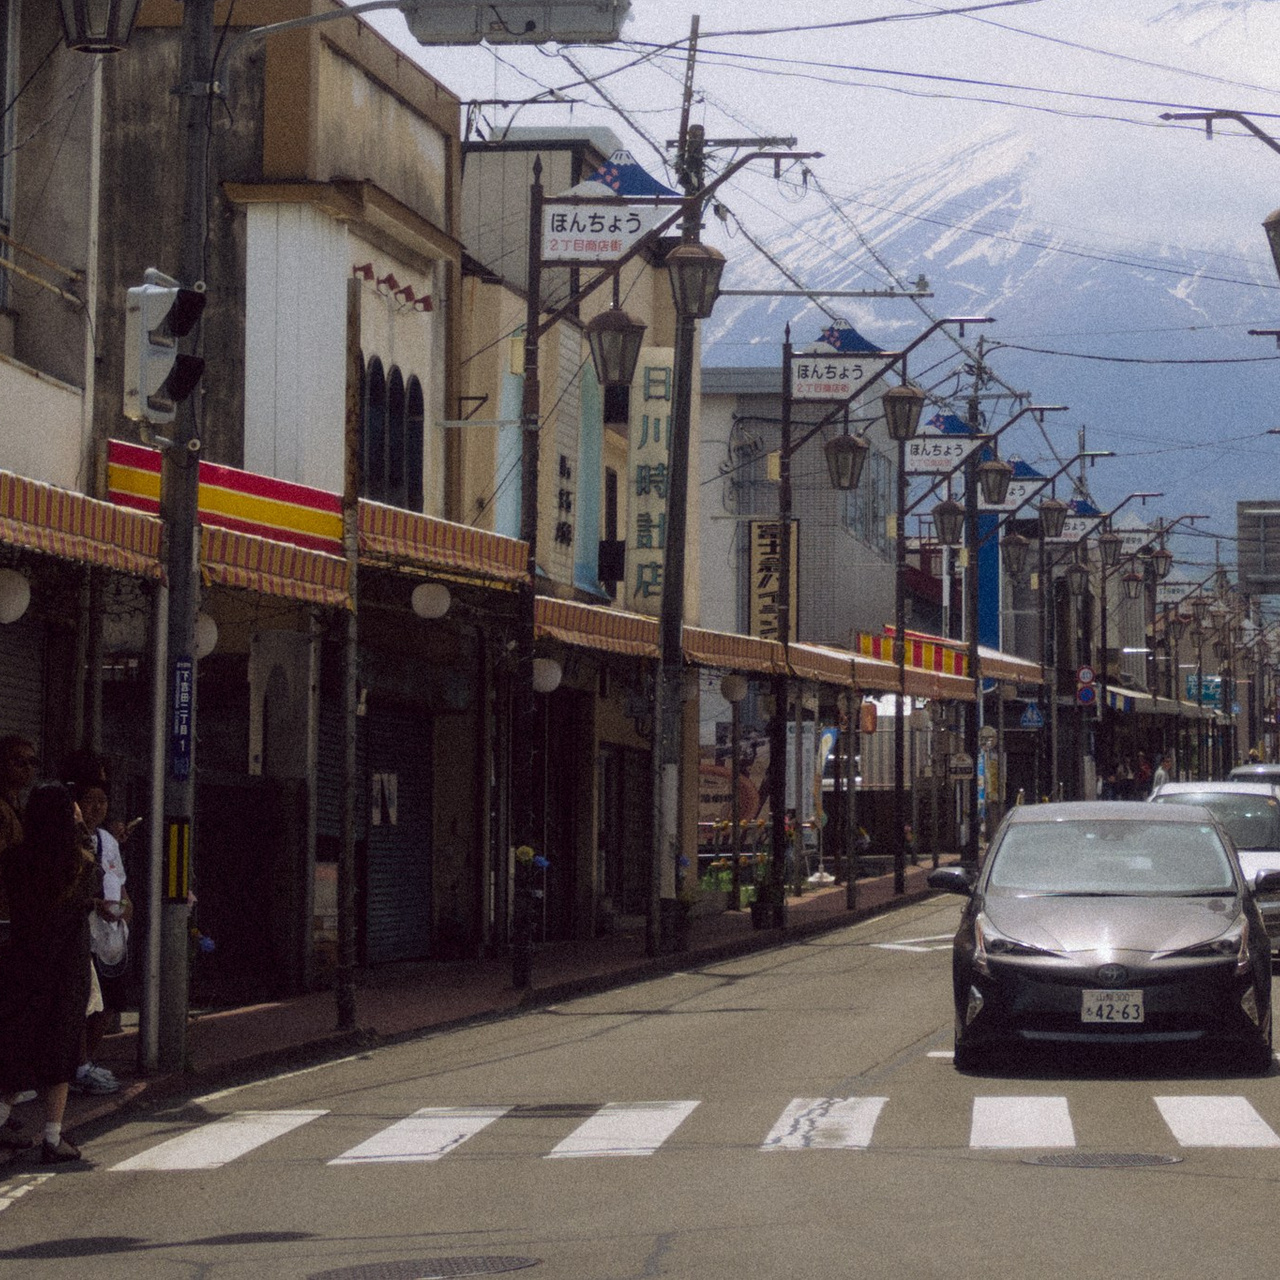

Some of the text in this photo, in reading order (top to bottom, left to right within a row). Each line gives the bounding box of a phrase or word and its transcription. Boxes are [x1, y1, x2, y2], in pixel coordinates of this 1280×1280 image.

[551, 213, 641, 234] ほんちょう
[550, 239, 623, 252] 2丁目商店街
[797, 364, 863, 380] ほんちょう
[910, 444, 963, 457] ほんちょう
[634, 366, 672, 600] 日川時計店
[1063, 521, 1086, 532] ちょう
[1096, 1004, 1140, 1020] 42-63
